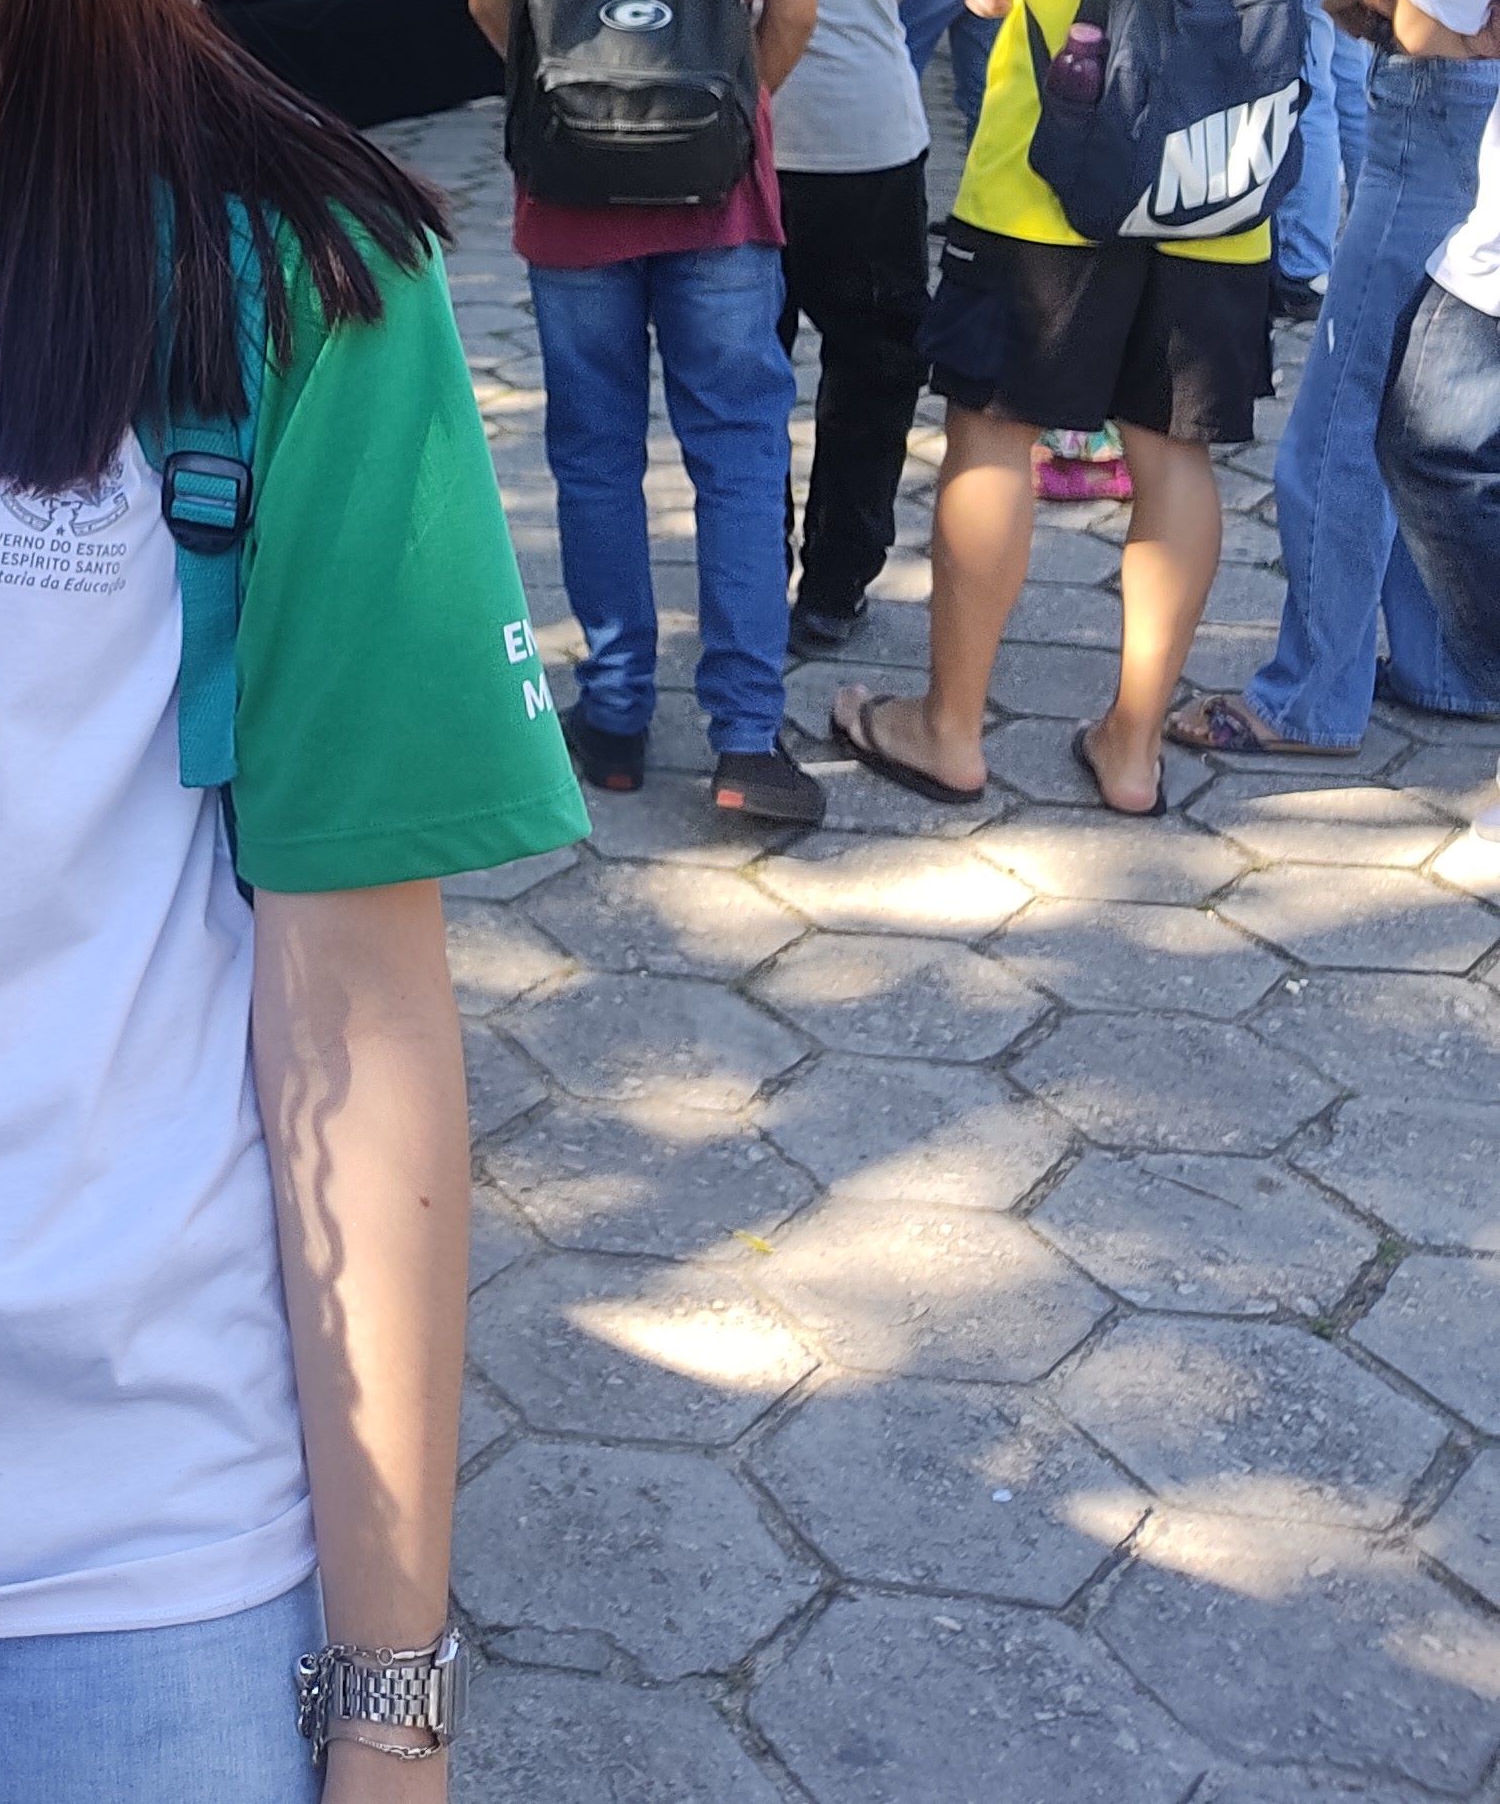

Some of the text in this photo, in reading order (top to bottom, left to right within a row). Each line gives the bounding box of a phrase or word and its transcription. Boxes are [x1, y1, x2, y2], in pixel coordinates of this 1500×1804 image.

[1155, 79, 1300, 216] NIKE
[50, 539, 71, 554] DO
[76, 542, 127, 557] ESTADO
[1, 551, 70, 573] ESPÍRITO
[75, 560, 120, 575] SANTO
[40, 574, 60, 590] da
